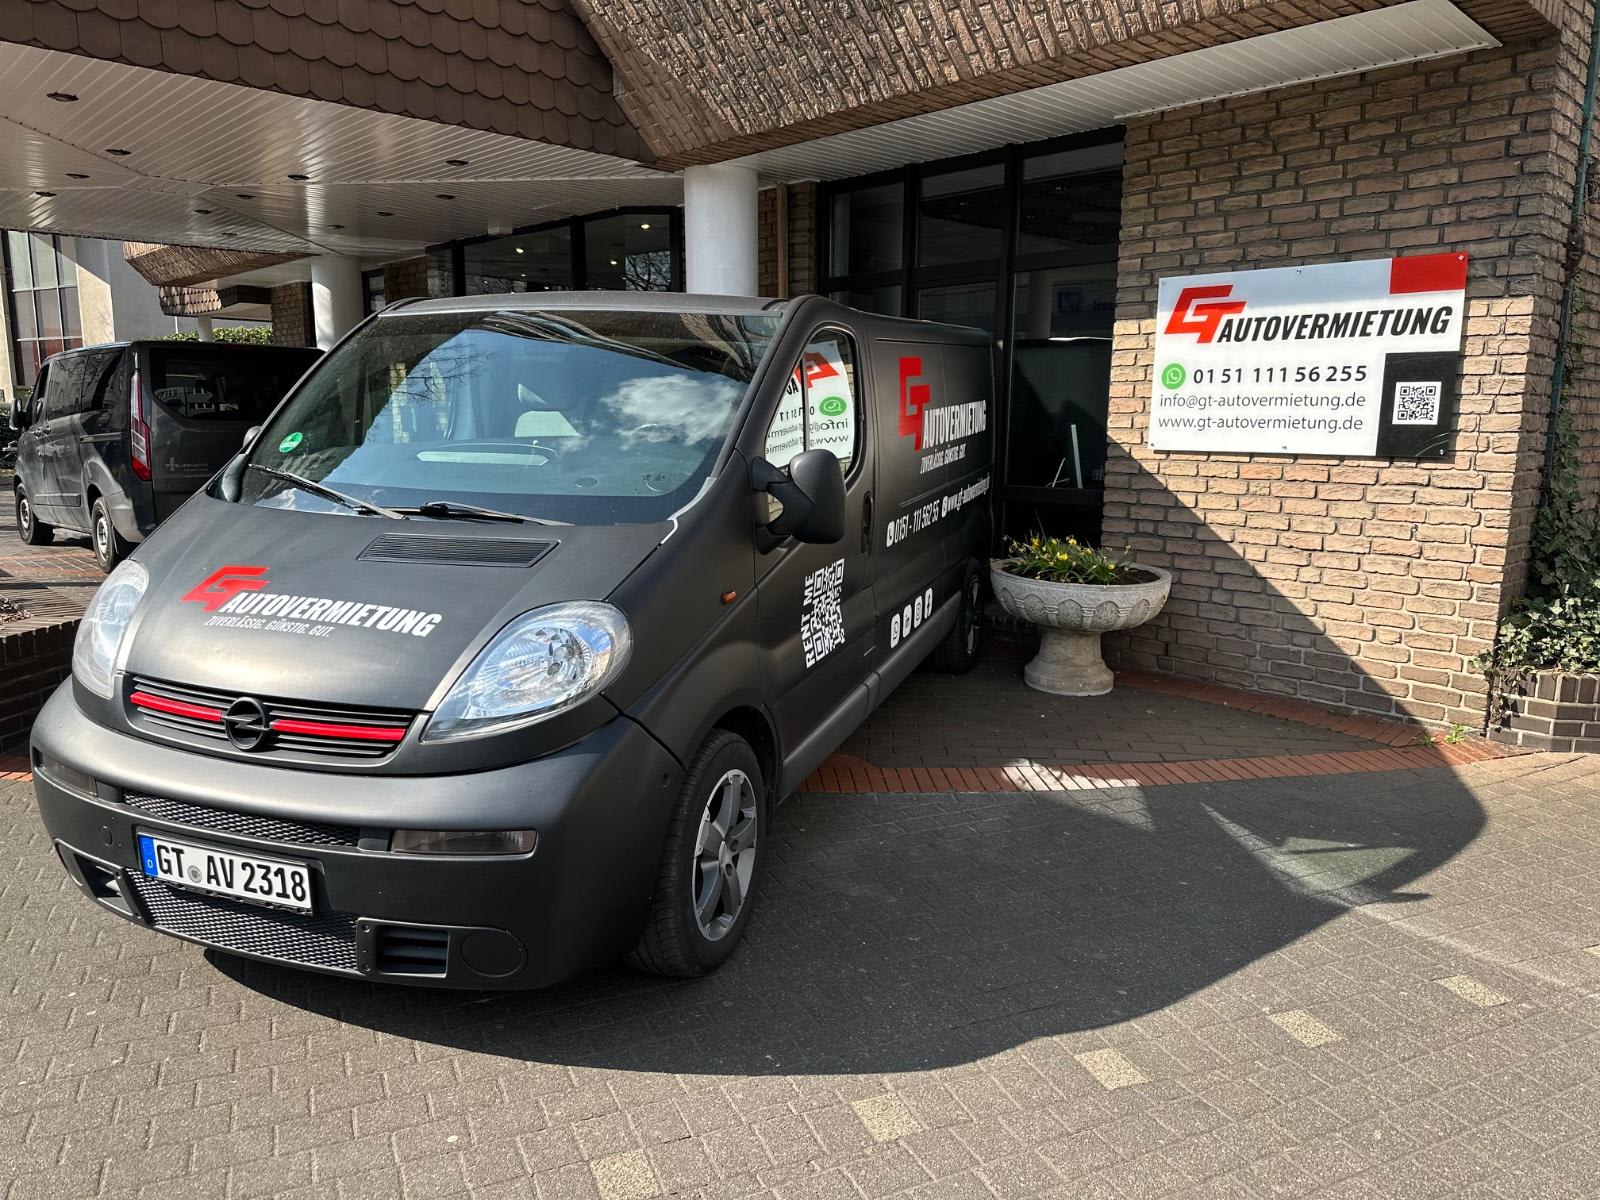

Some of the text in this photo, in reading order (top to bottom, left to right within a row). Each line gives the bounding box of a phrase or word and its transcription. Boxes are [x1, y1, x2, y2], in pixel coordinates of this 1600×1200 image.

[1164, 284, 1453, 344] GT AUTOVERMIETUNG
[1253, 366, 1287, 383] 111
[1326, 365, 1367, 382] 255
[899, 356, 987, 451] GT AUTOVERMIETUNG
[1159, 391, 1366, 411] info@gt-autovermietung.de
[1158, 415, 1364, 433] www.gt-autovermietung.de
[894, 514, 910, 543] 0151
[180, 565, 443, 638] GT AUTOVERMIETUNG
[800, 572, 816, 669] RENT ME
[308, 624, 335, 638] GUT.
[156, 844, 185, 878] GT
[206, 855, 235, 889] AV
[241, 861, 307, 902] 2318
